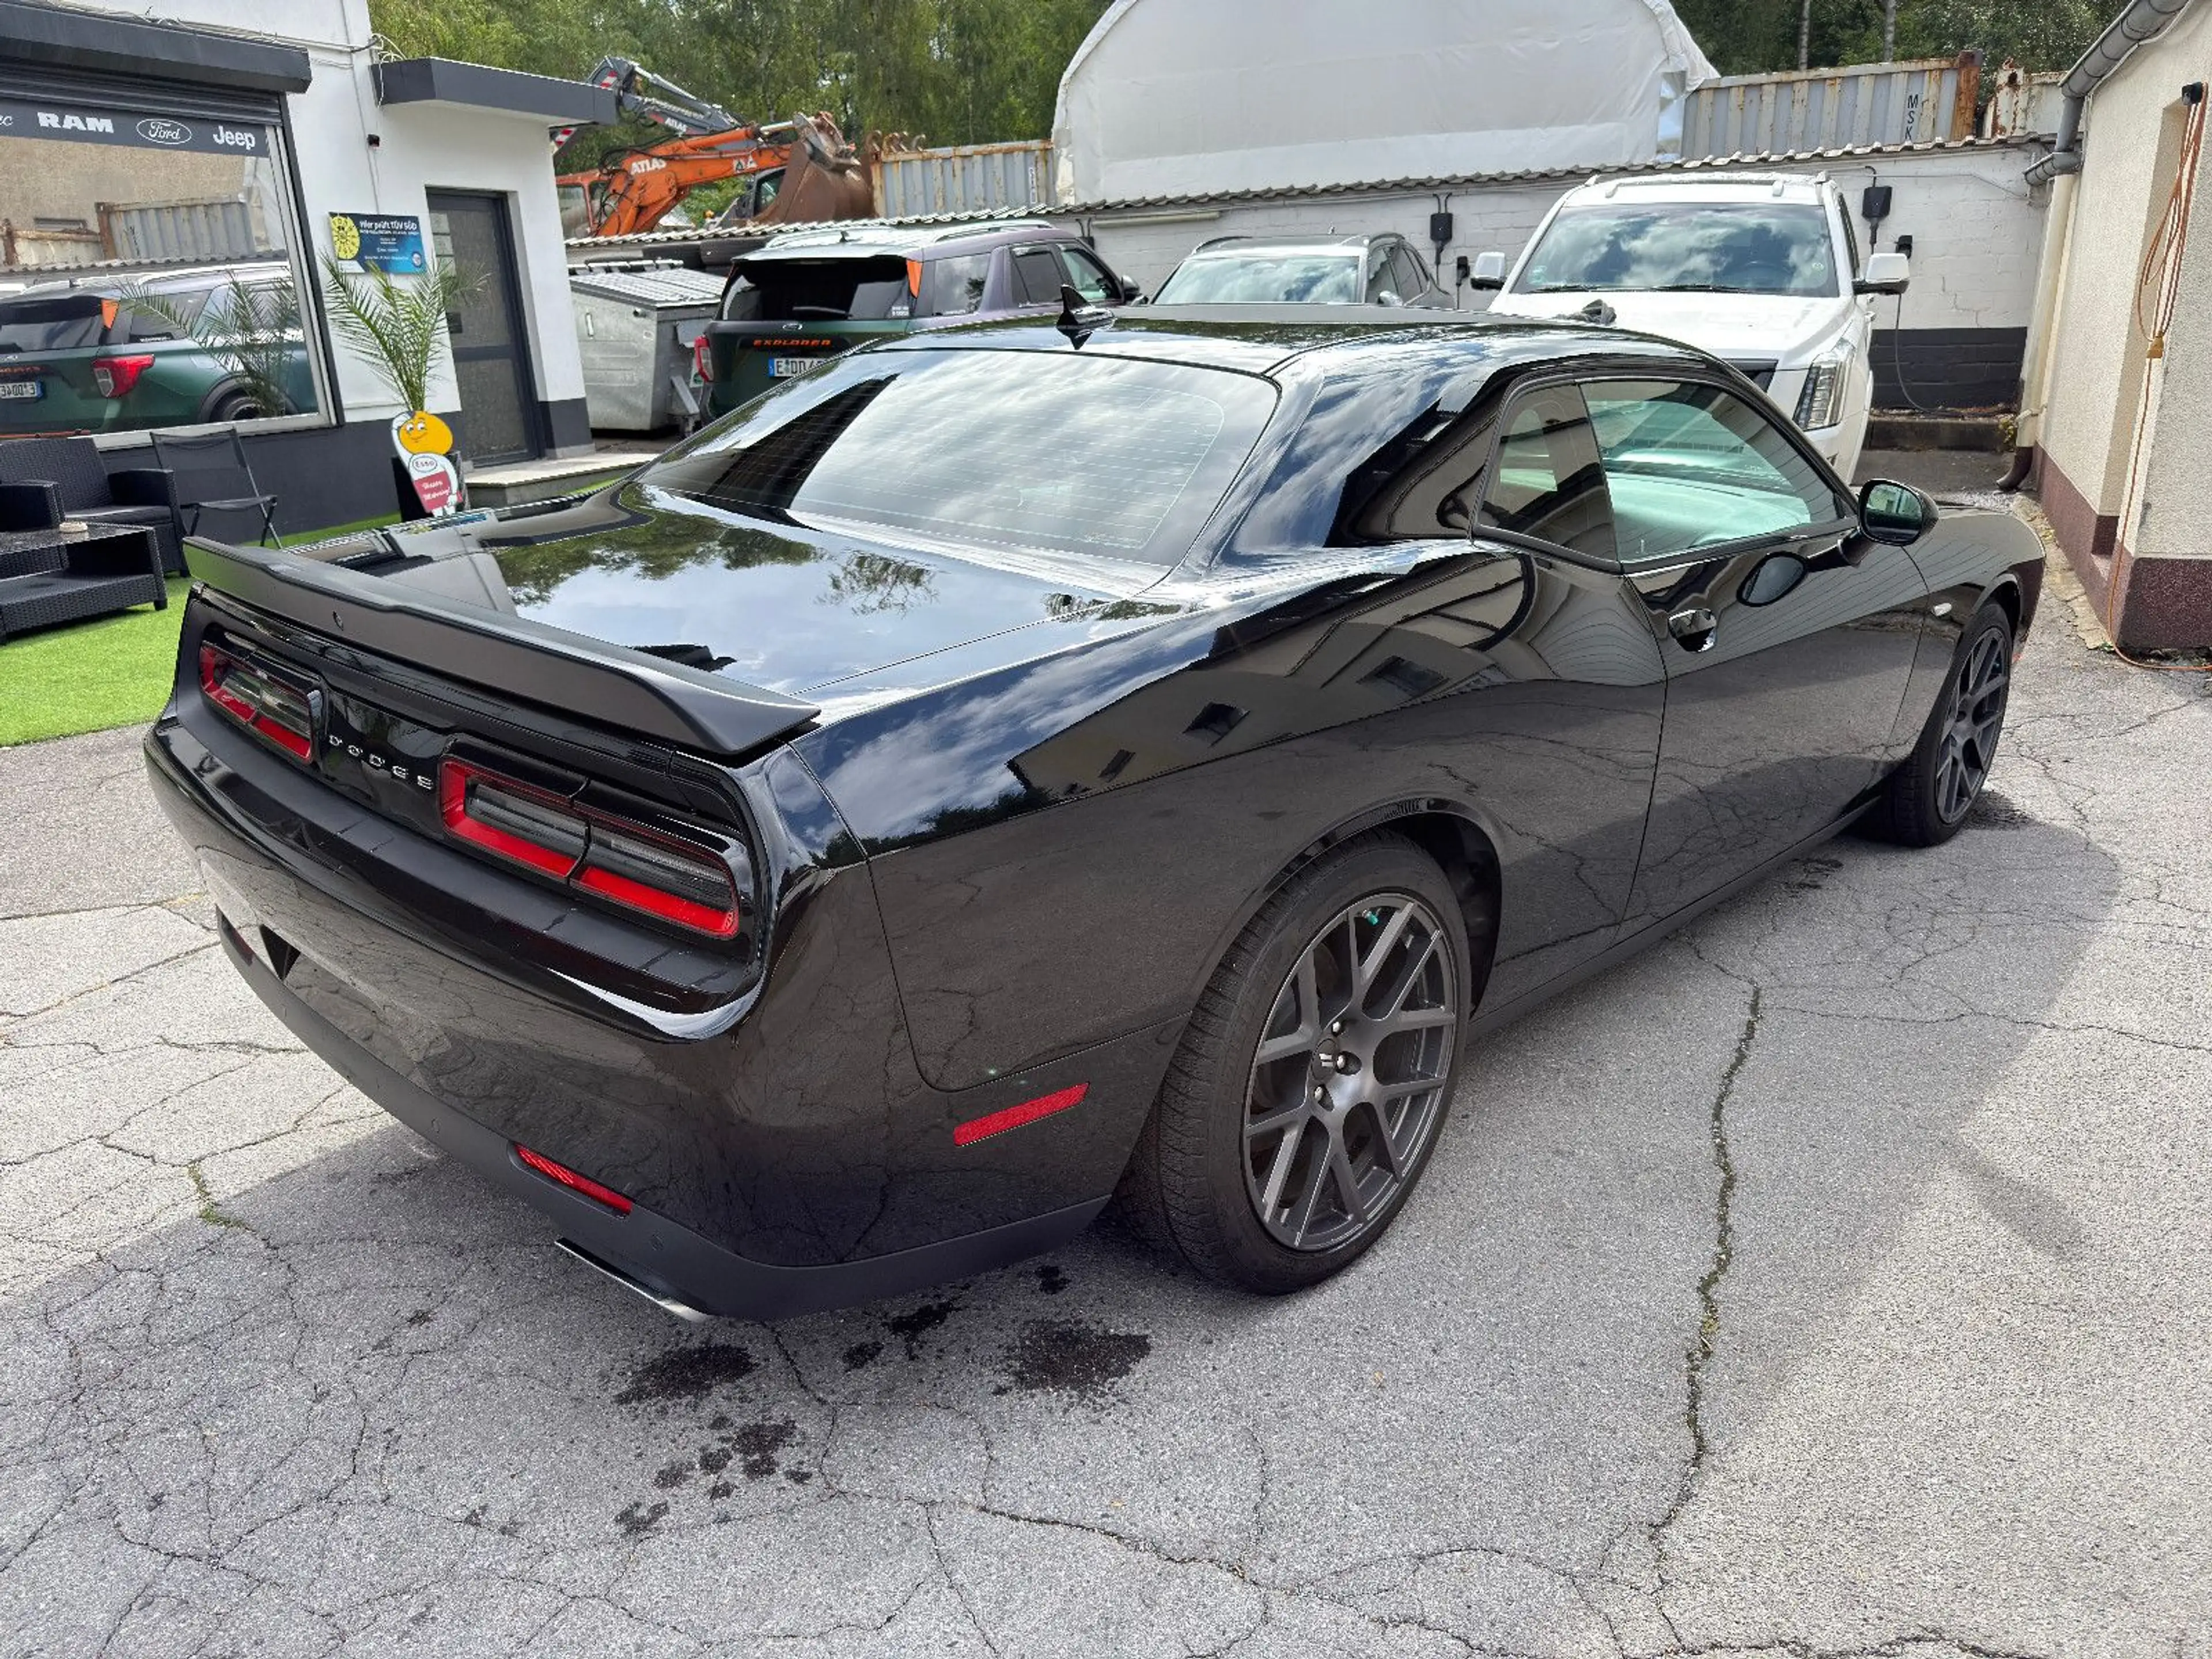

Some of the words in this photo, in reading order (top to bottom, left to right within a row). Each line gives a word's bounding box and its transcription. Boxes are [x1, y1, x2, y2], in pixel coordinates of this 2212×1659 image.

[37, 111, 114, 133] RAM
[148, 122, 181, 139] Ford
[664, 117, 688, 133] ATLAS
[213, 124, 255, 150] Jeep
[630, 157, 667, 175] ATLAS
[329, 734, 432, 790] DODGE
